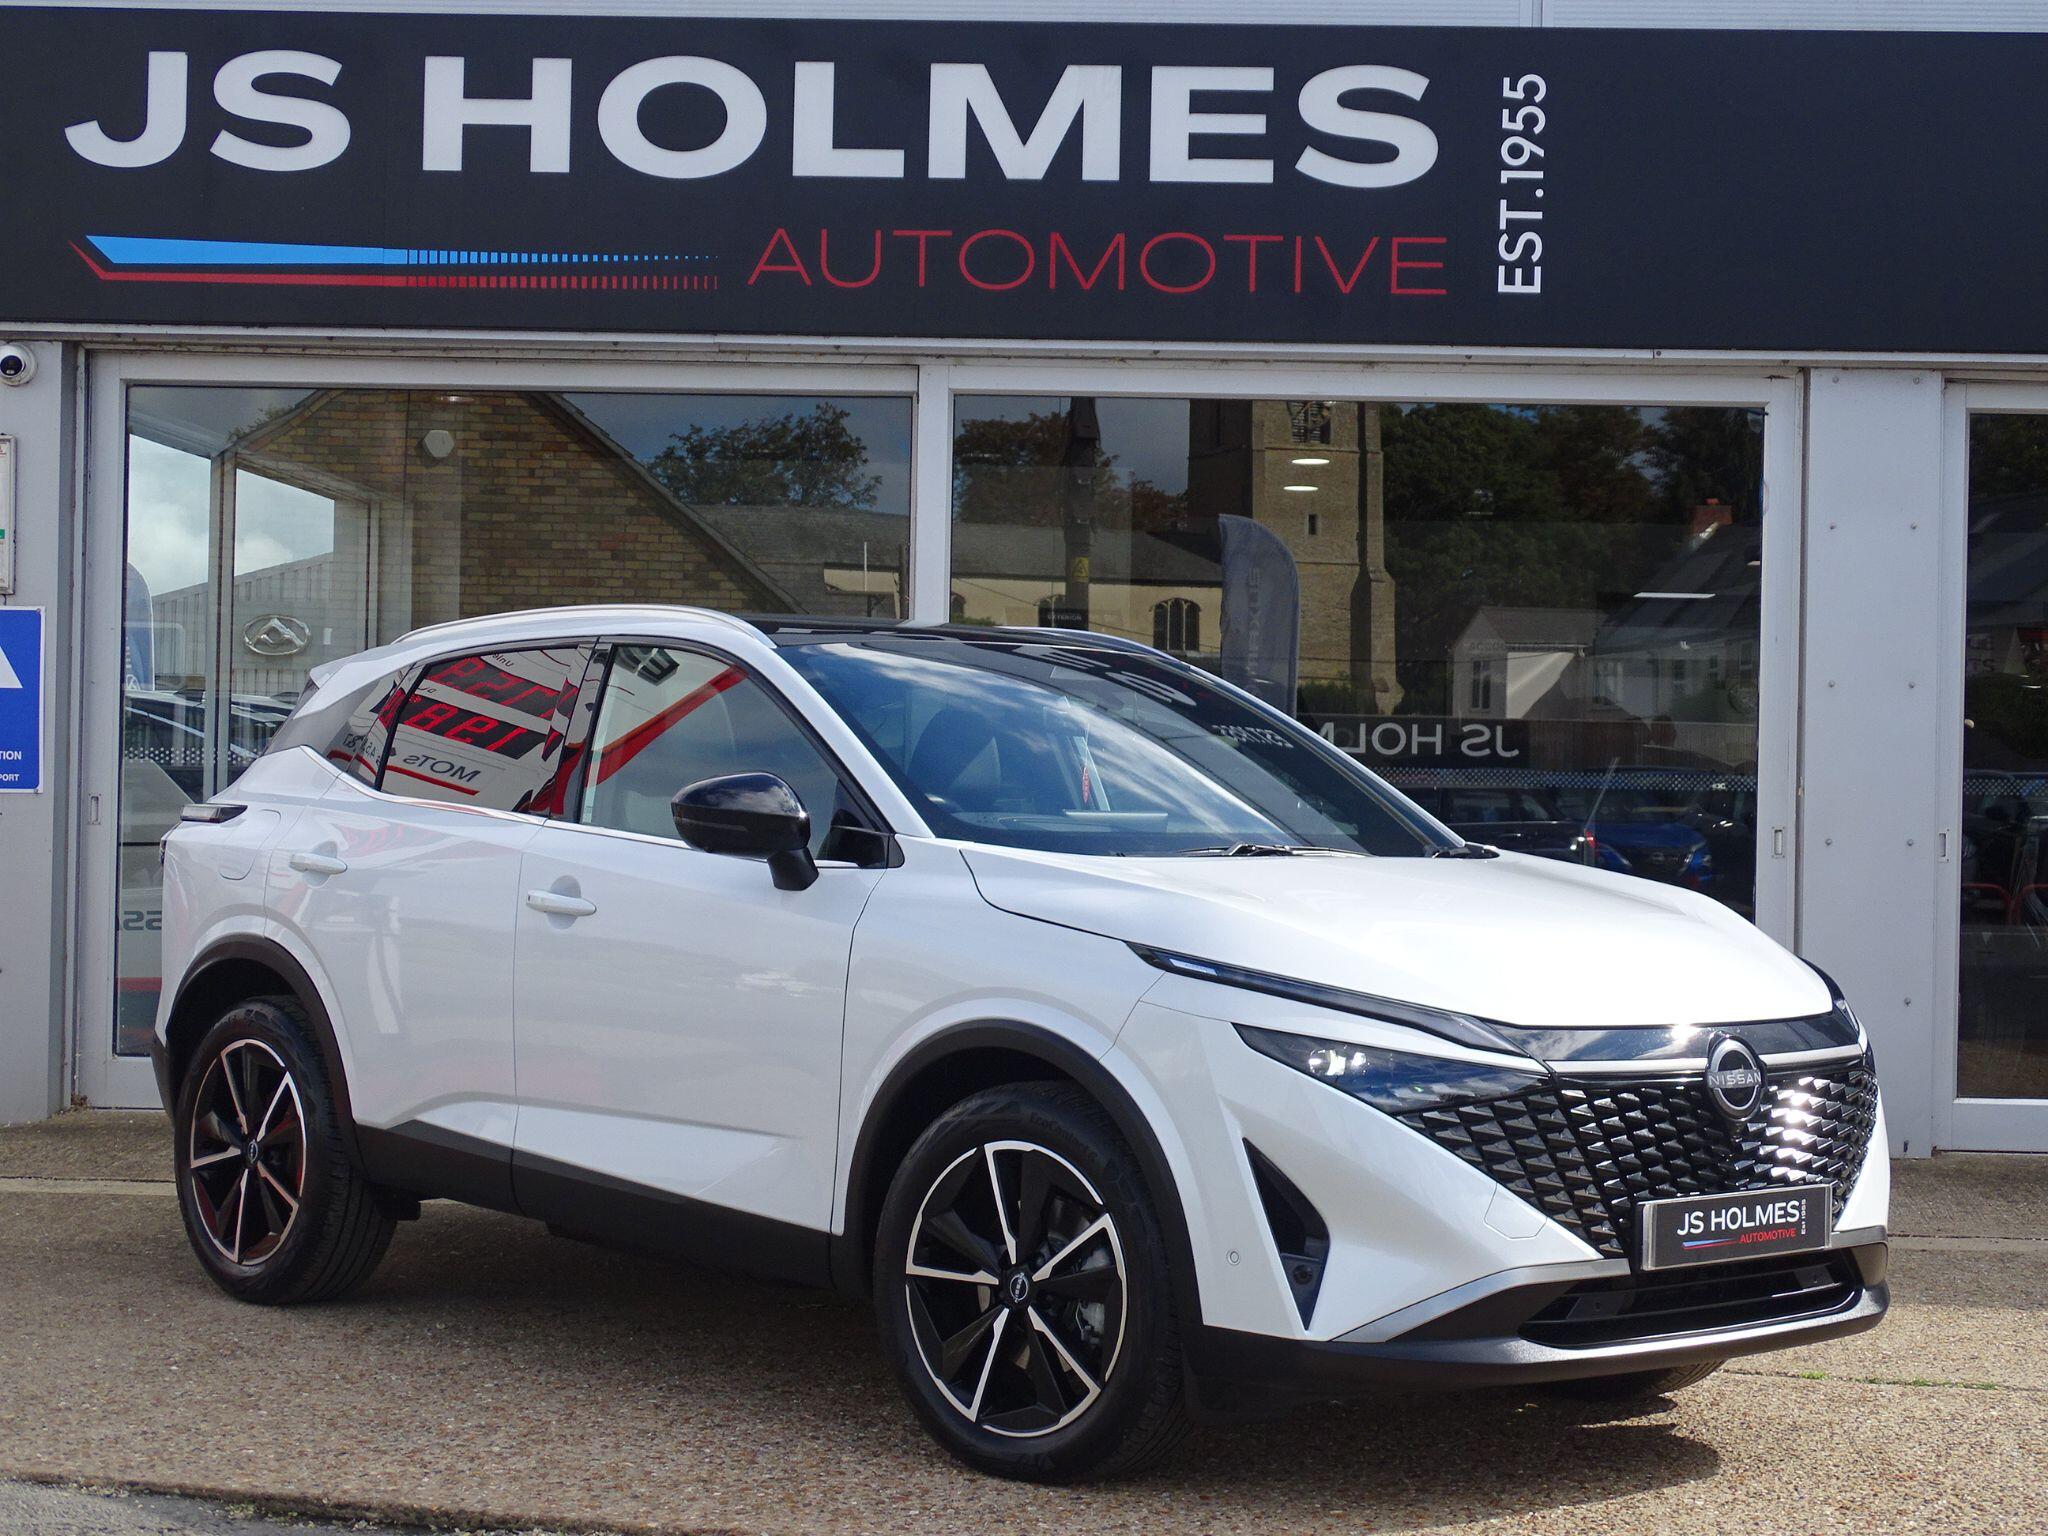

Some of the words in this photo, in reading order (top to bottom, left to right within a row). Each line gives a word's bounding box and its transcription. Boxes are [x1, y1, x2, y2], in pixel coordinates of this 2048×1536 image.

[65, 49, 352, 172] JS
[422, 55, 1440, 189] HOLMES
[1497, 73, 1547, 295] EST.1955
[746, 227, 1448, 296] AUTOMOTIVE
[1708, 1071, 1762, 1086] NISSAN
[1677, 1211, 1704, 1236] JS
[1711, 1199, 1800, 1232] HOLMES
[1740, 1228, 1796, 1243] AUTOMOTIVE
